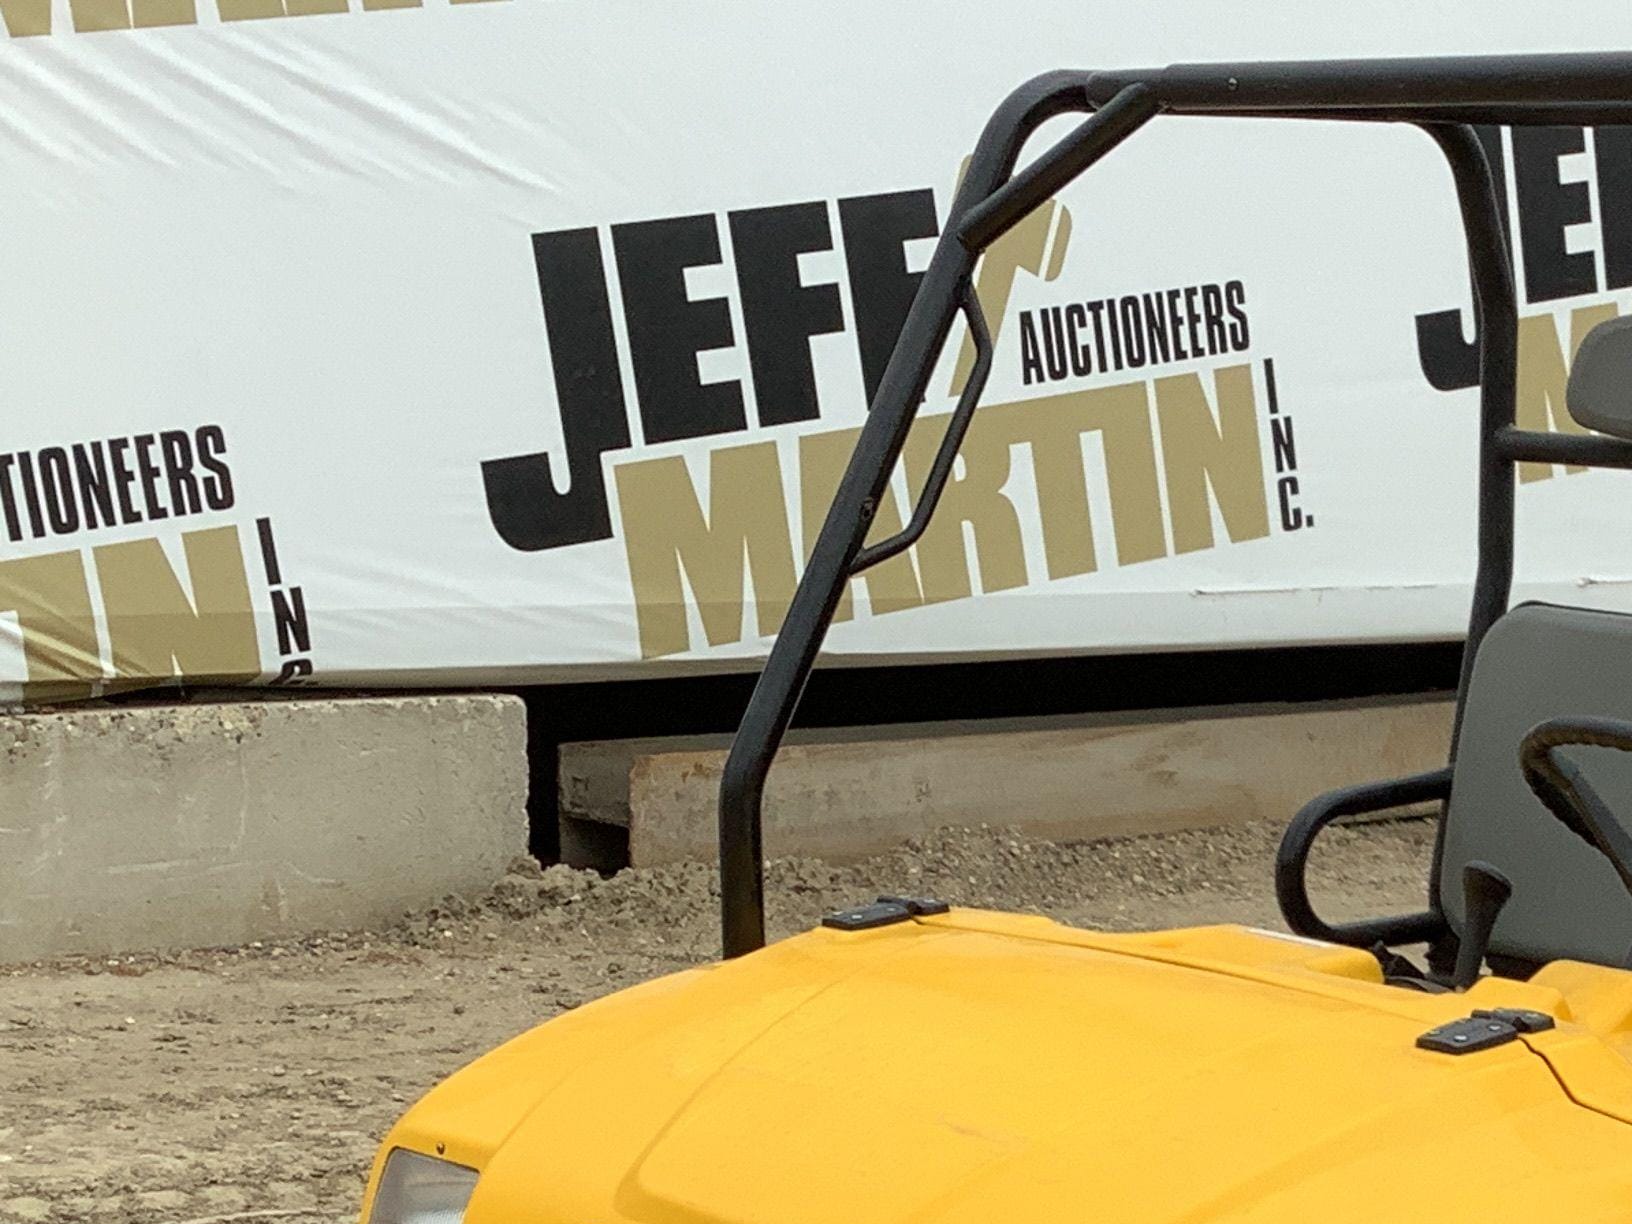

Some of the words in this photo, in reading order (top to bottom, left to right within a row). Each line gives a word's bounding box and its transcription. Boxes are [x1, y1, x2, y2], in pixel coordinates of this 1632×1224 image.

[480, 186, 941, 553] JEFF
[1019, 279, 1251, 387] AUCTIONEERS
[612, 362, 1271, 661] MARTIN
